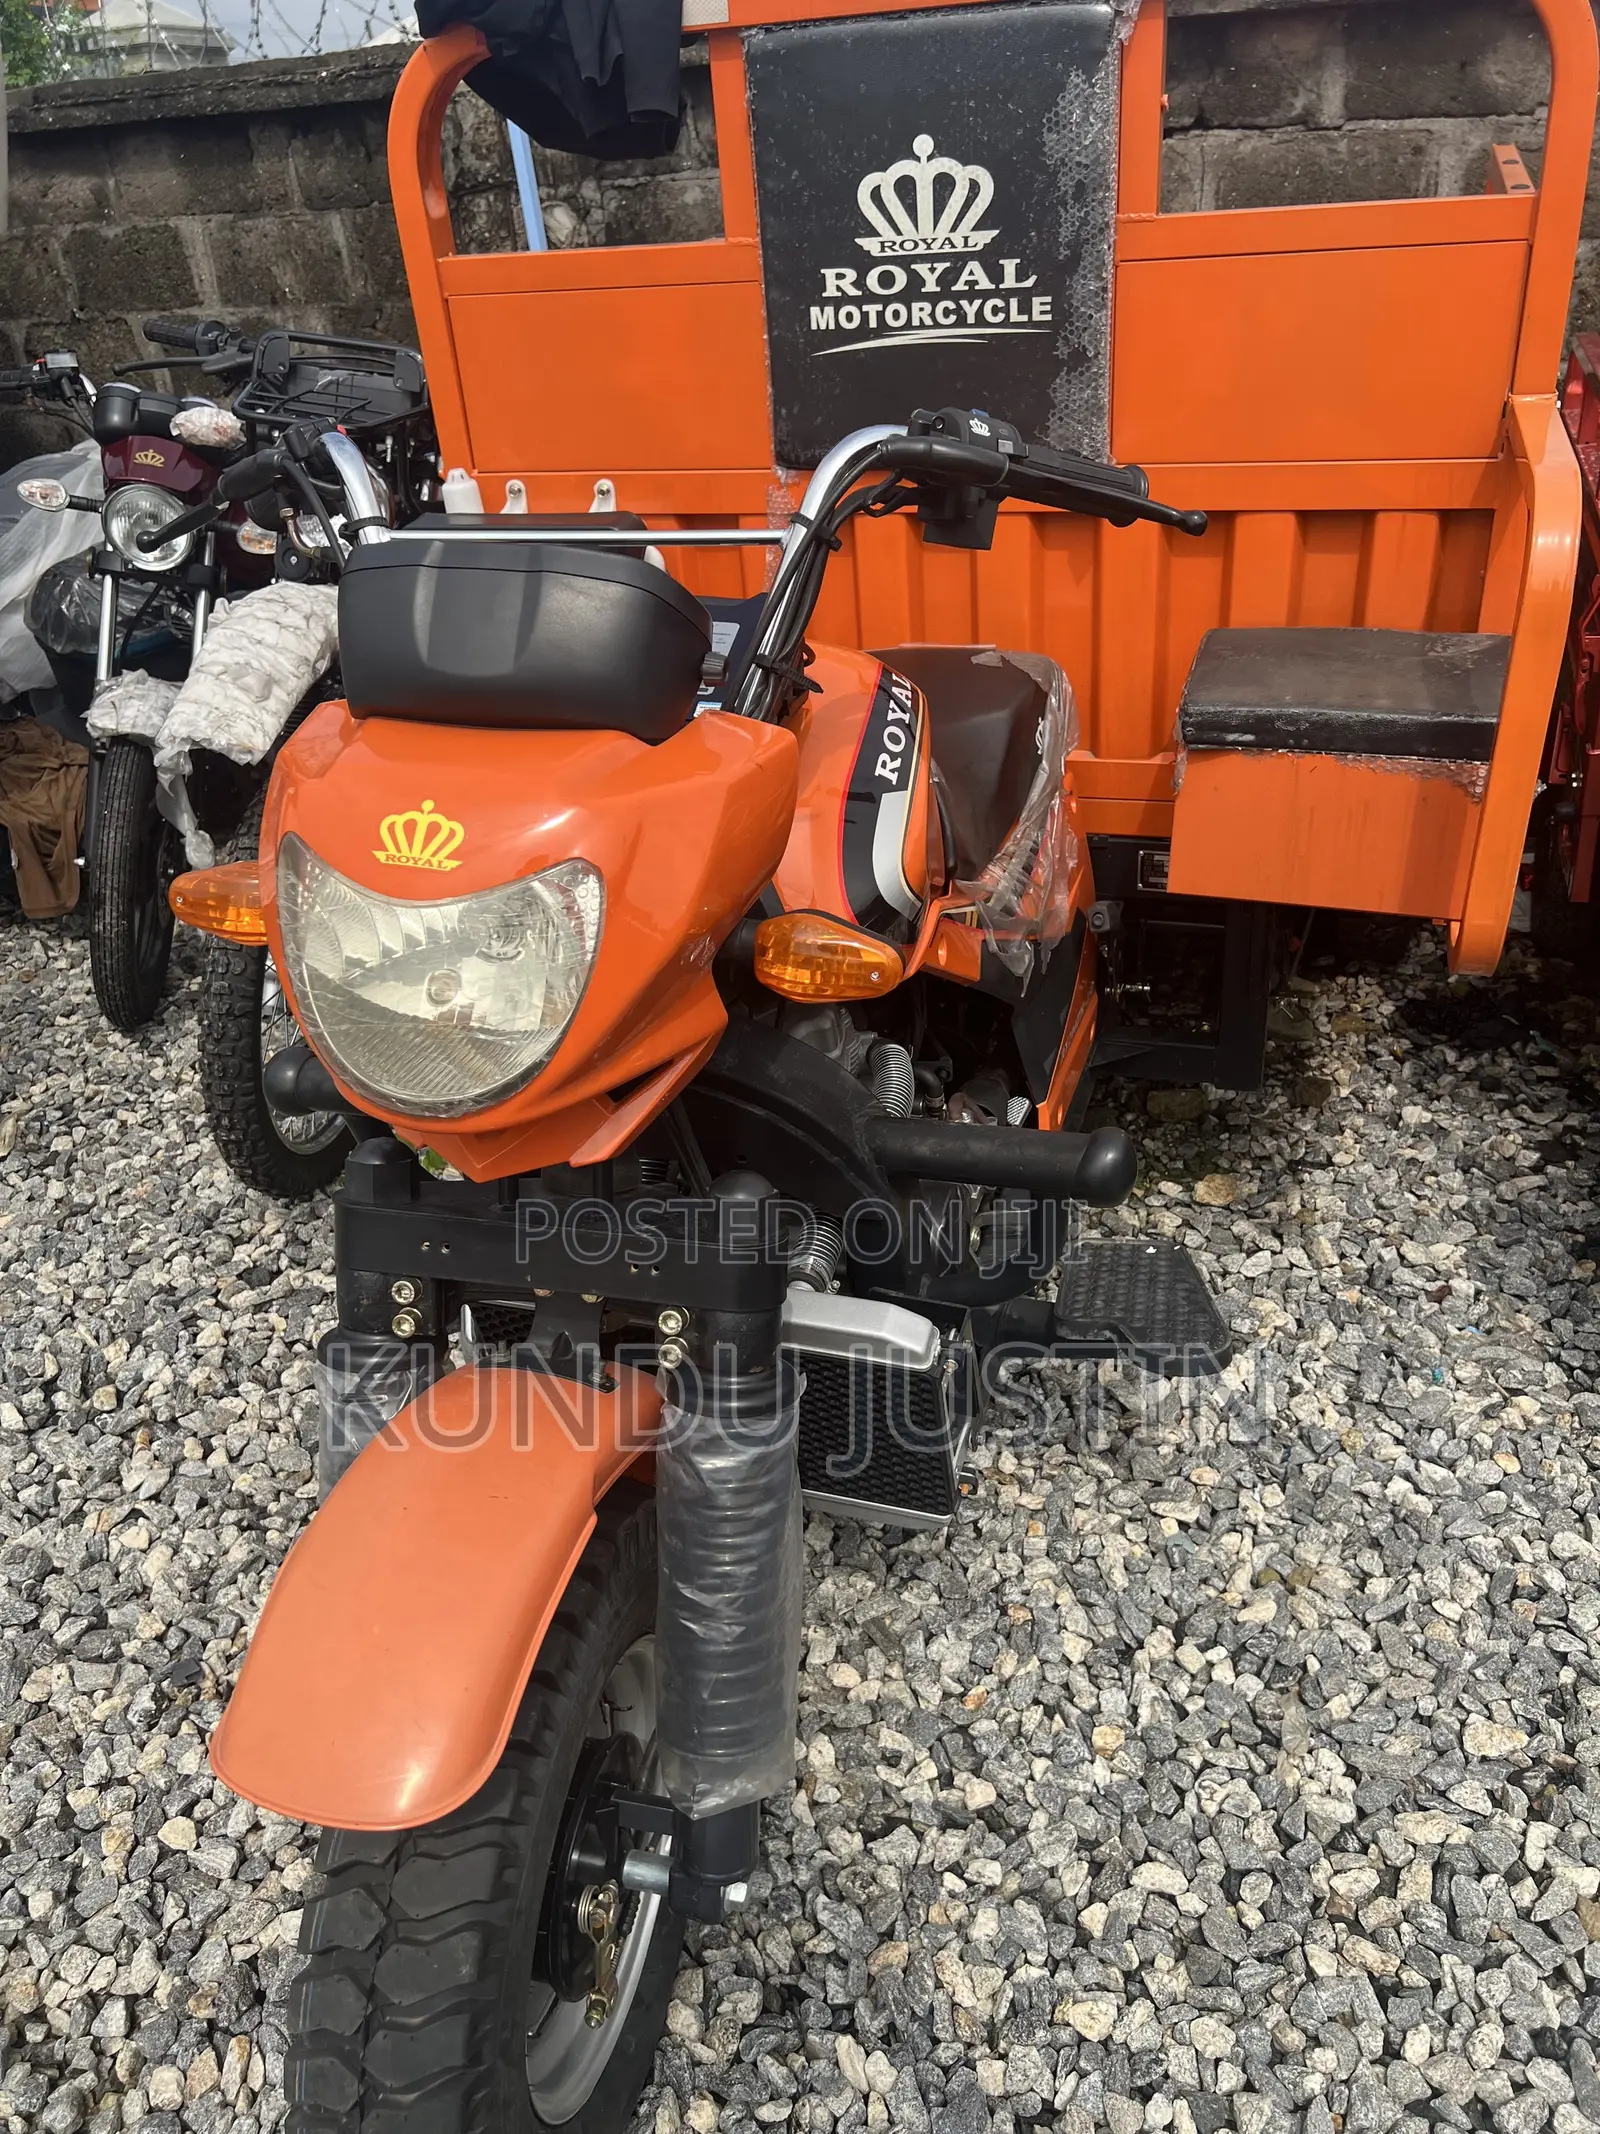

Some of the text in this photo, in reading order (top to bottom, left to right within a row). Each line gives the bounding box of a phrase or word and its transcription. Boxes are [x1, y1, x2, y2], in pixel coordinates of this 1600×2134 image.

[878, 235, 980, 254] ROYAL
[820, 258, 1038, 298] ROYAL
[809, 296, 1053, 330] MOTORCYCLE
[874, 672, 913, 786] ROYAL
[384, 853, 449, 869] ROYAL
